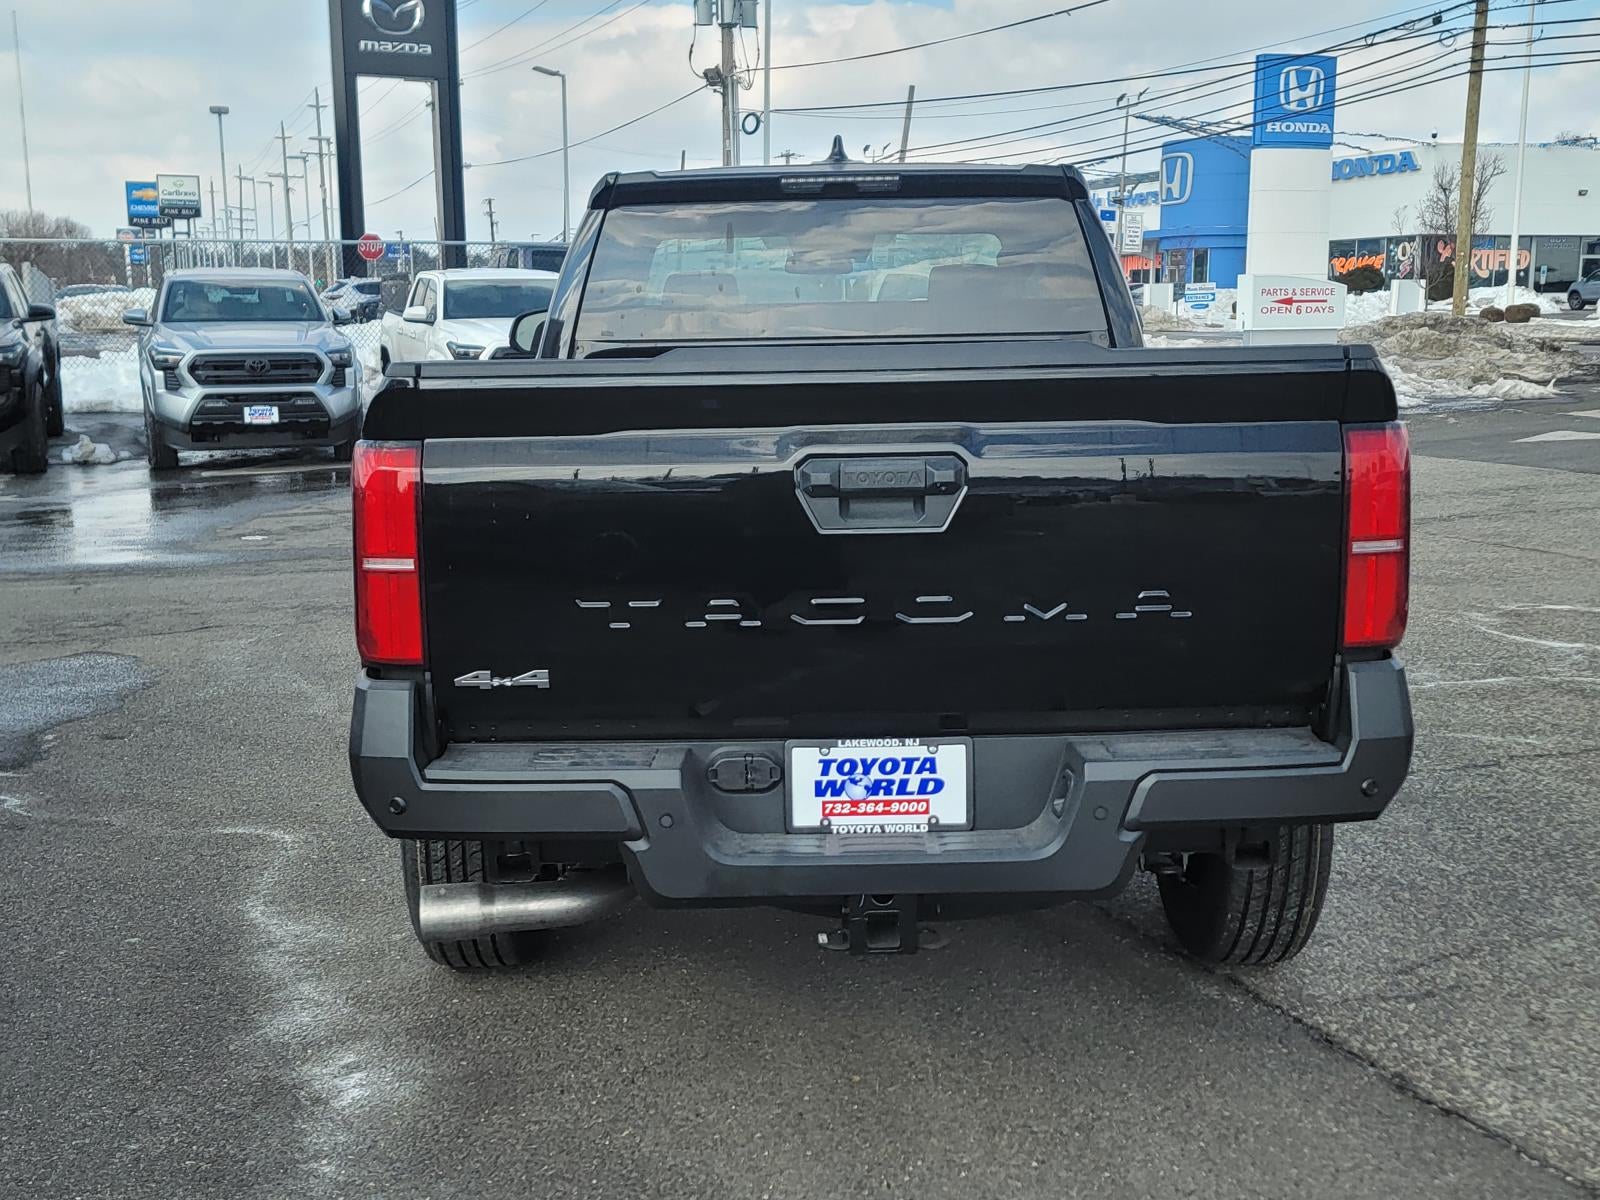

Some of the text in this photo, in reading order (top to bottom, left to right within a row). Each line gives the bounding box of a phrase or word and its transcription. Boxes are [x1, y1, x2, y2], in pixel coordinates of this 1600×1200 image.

[1265, 122, 1332, 134] HONDA
[1332, 151, 1421, 181] ONDA
[360, 242, 383, 252] STOP
[1261, 287, 1336, 296] PARTS & SERVICE
[1260, 305, 1335, 315] OPEN 6 DAYS
[844, 470, 922, 485] TOYOTA
[905, 738, 920, 746] NJ
[817, 757, 938, 777] TOYOTA
[814, 776, 944, 800] WORLD
[824, 801, 928, 814] 732-364-9000
[831, 823, 929, 834] TOYOTA WORLD
